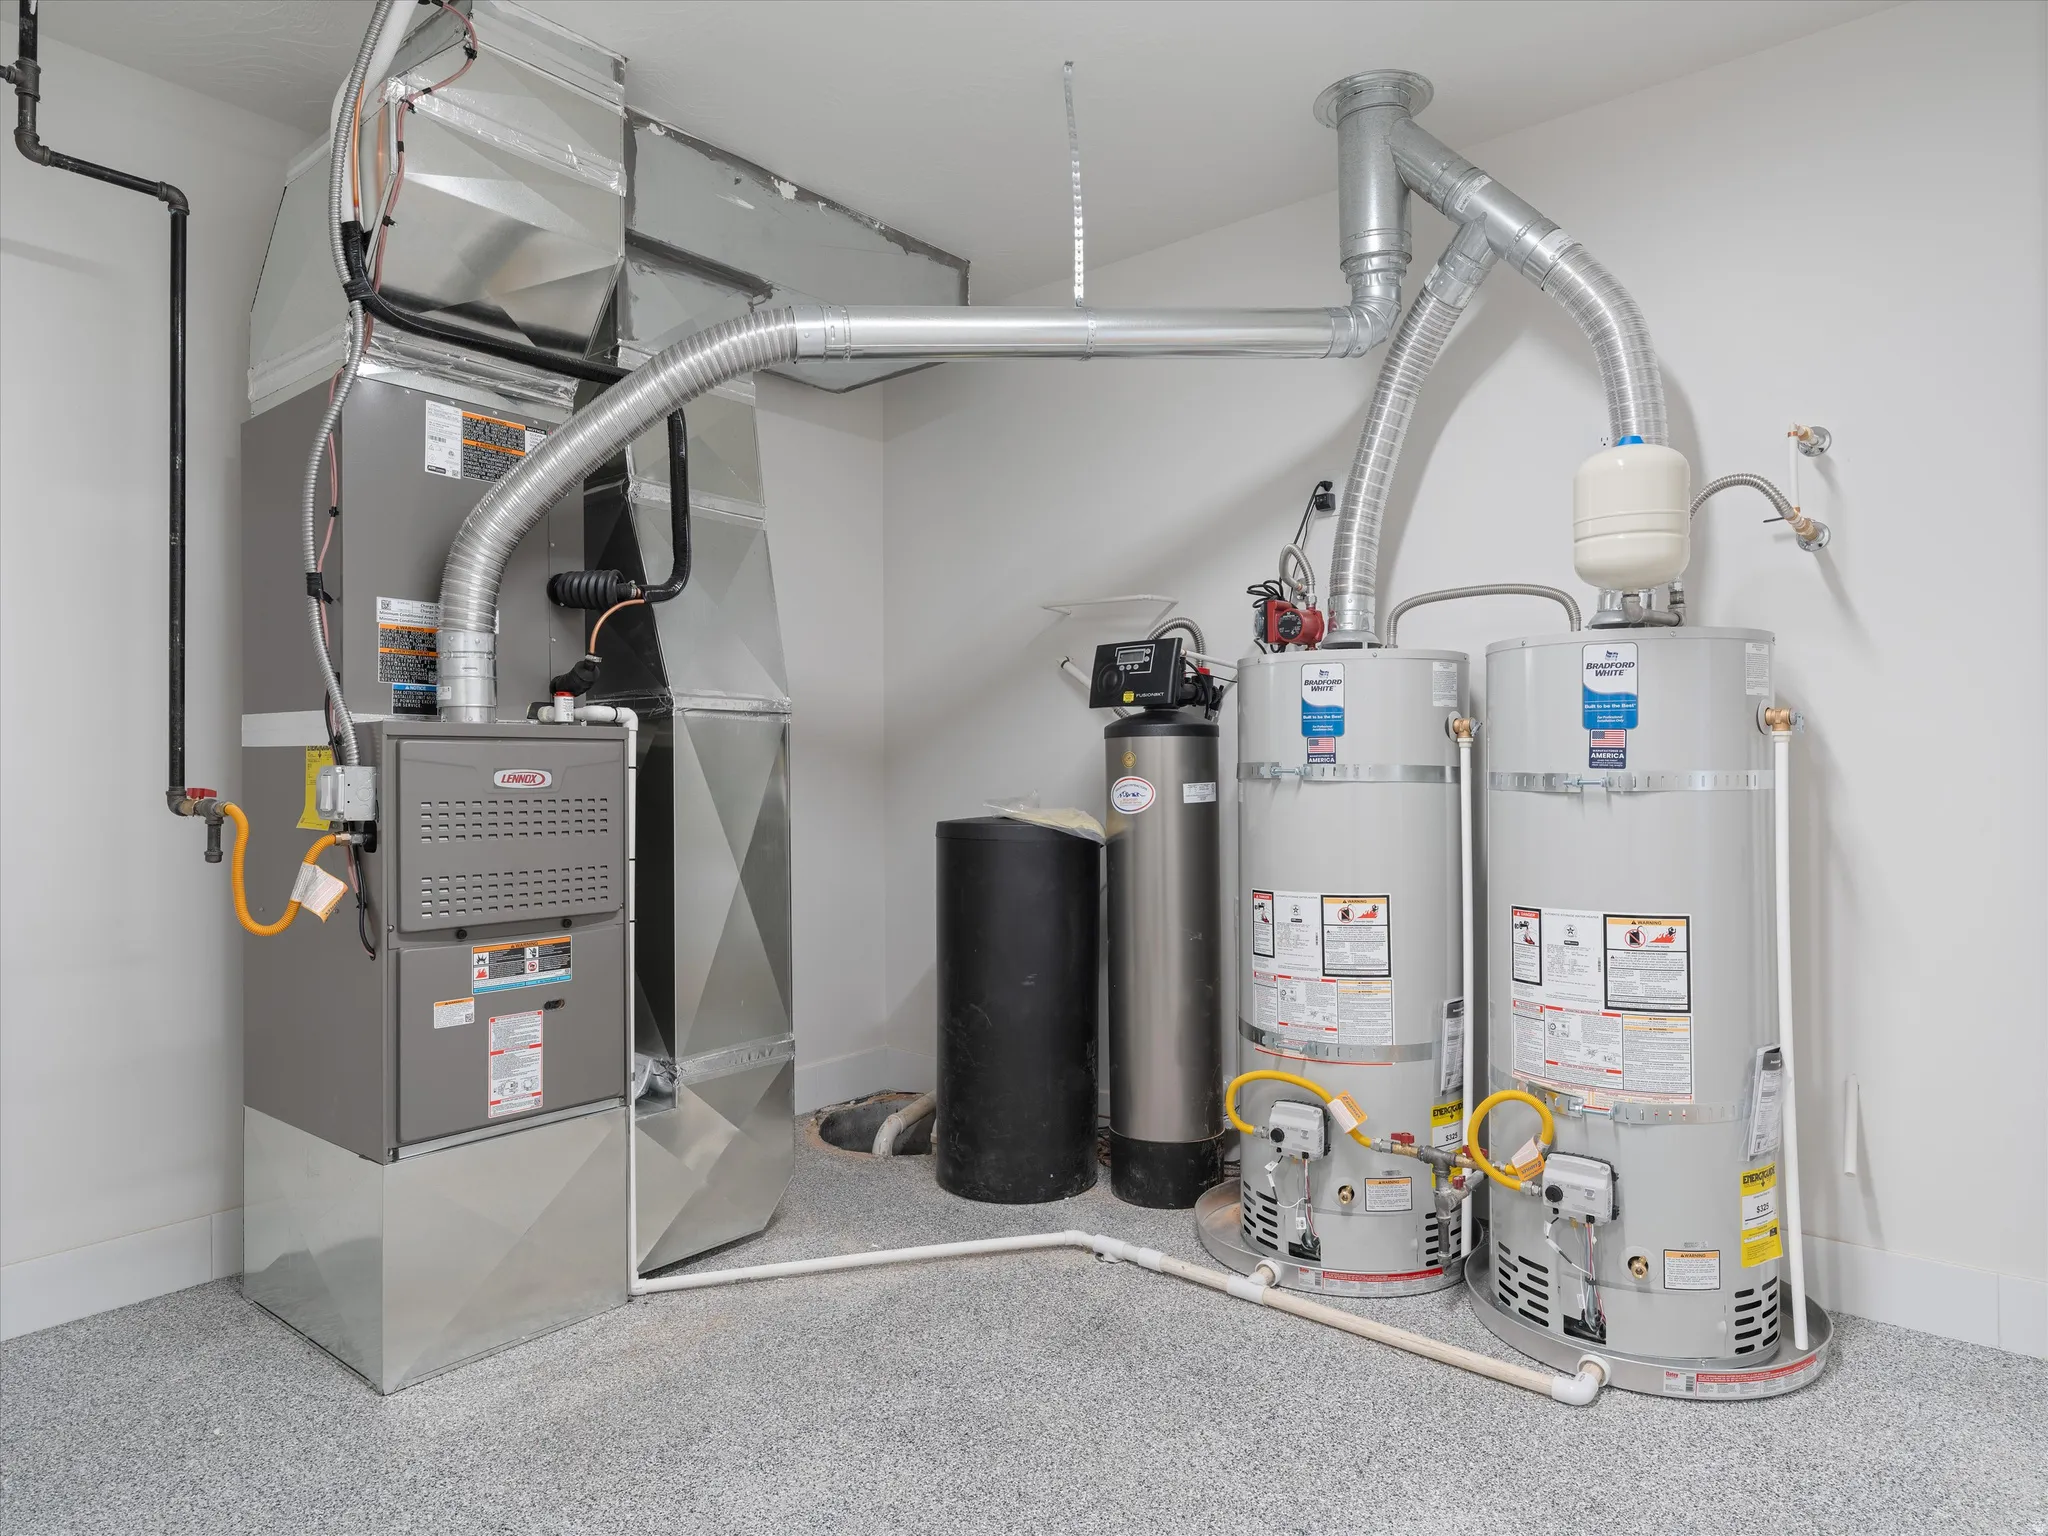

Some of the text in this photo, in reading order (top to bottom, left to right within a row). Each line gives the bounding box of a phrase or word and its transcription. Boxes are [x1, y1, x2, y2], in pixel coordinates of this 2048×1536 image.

[501, 774, 537, 783] LENNOX
[1446, 1132, 1458, 1141] $325
[1756, 1203, 1769, 1213] $325
